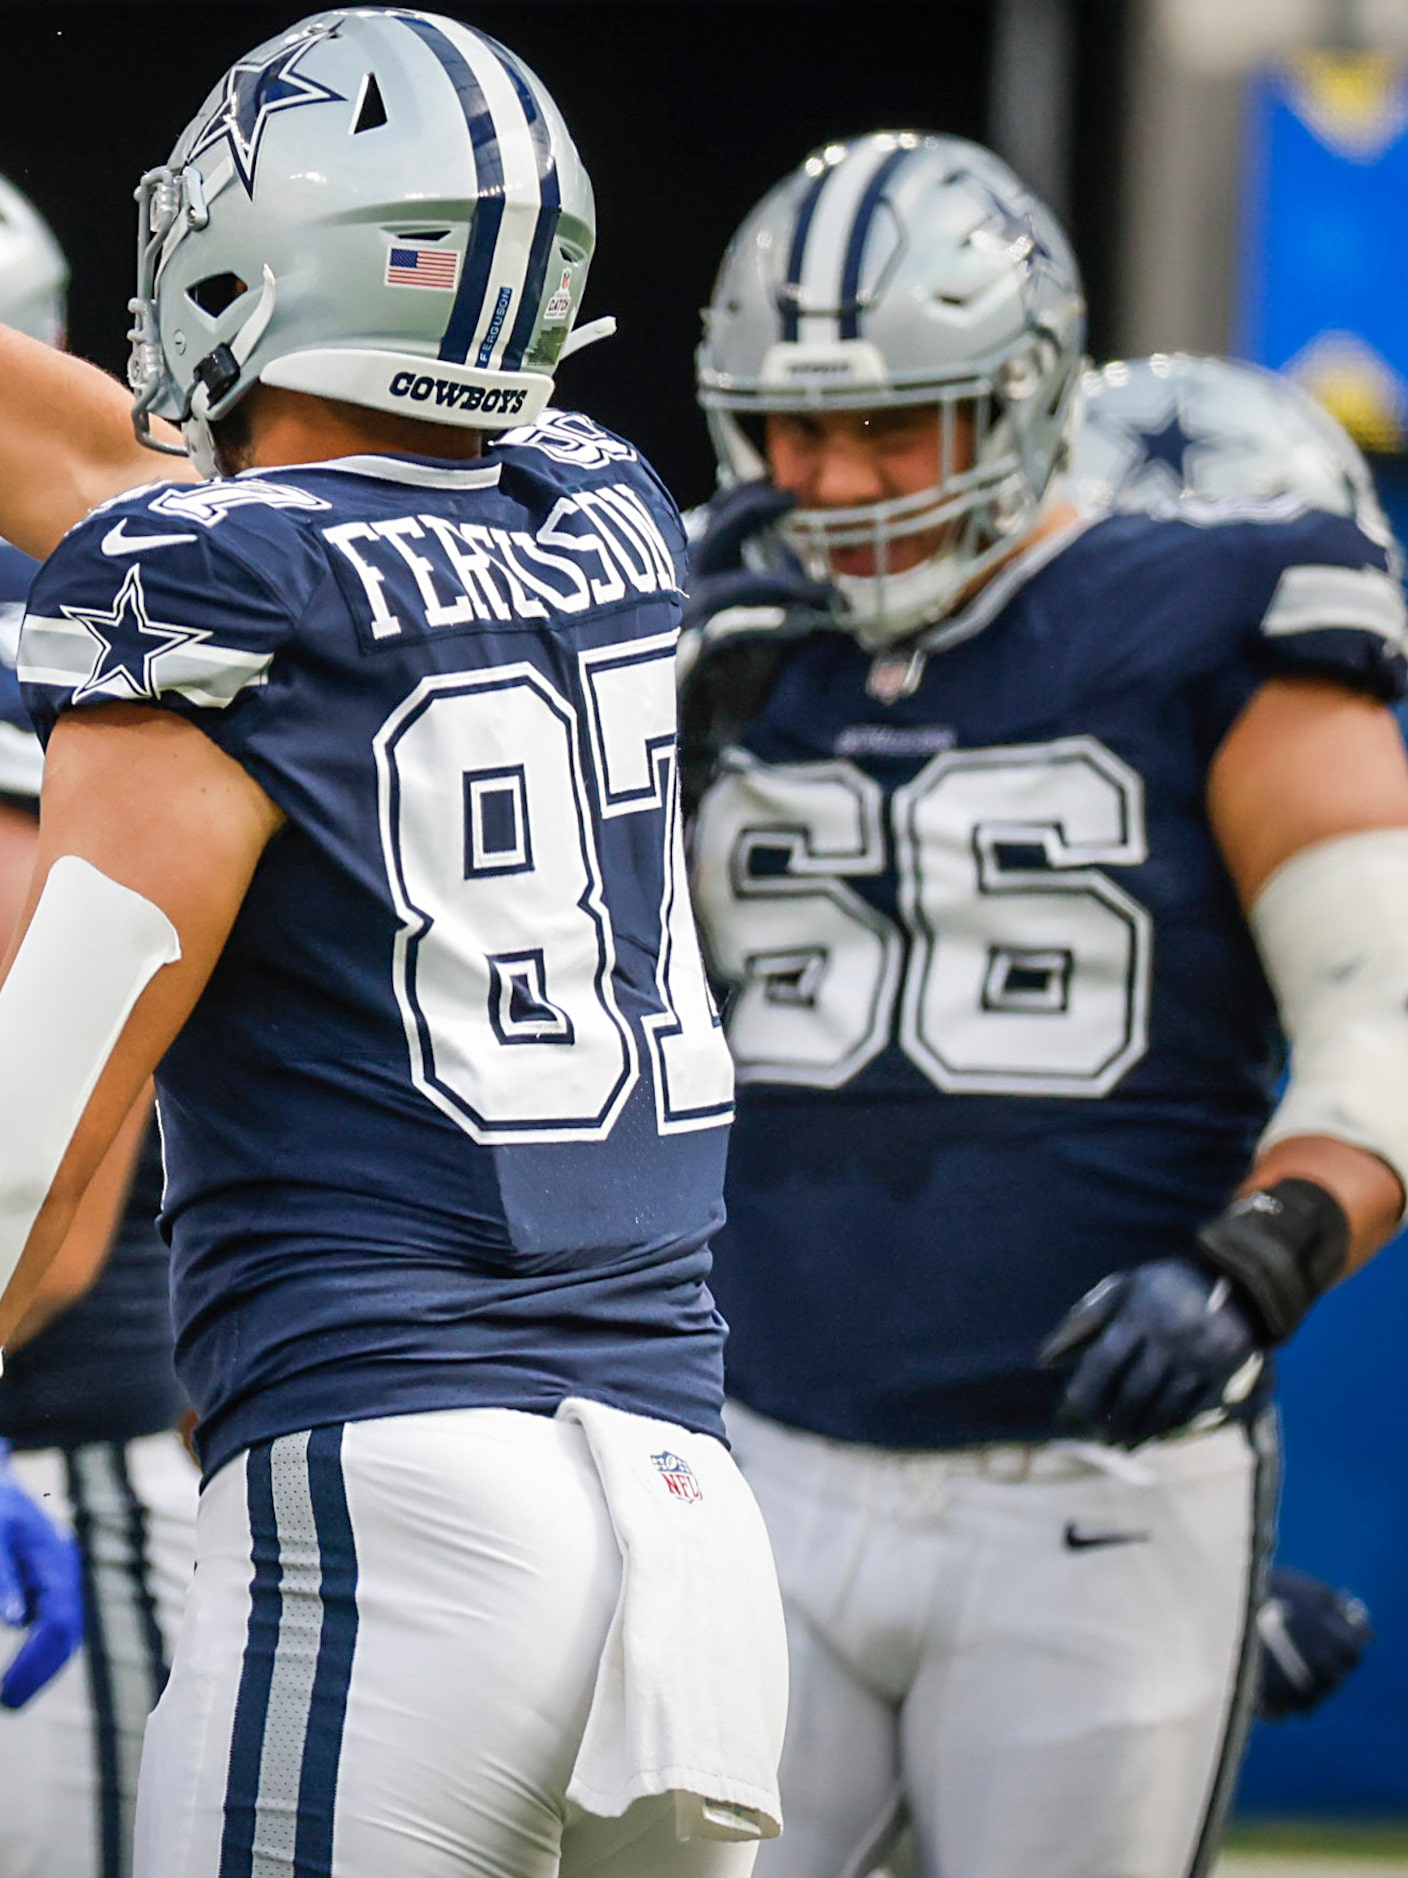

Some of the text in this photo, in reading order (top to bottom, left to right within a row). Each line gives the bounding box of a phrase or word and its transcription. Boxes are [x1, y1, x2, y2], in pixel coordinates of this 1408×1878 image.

[479, 286, 512, 363] FERGUSON
[389, 371, 528, 414] COWBOYS
[371, 627, 736, 1147] 87
[691, 734, 1154, 1099] 66
[660, 1472, 700, 1500] NFL
